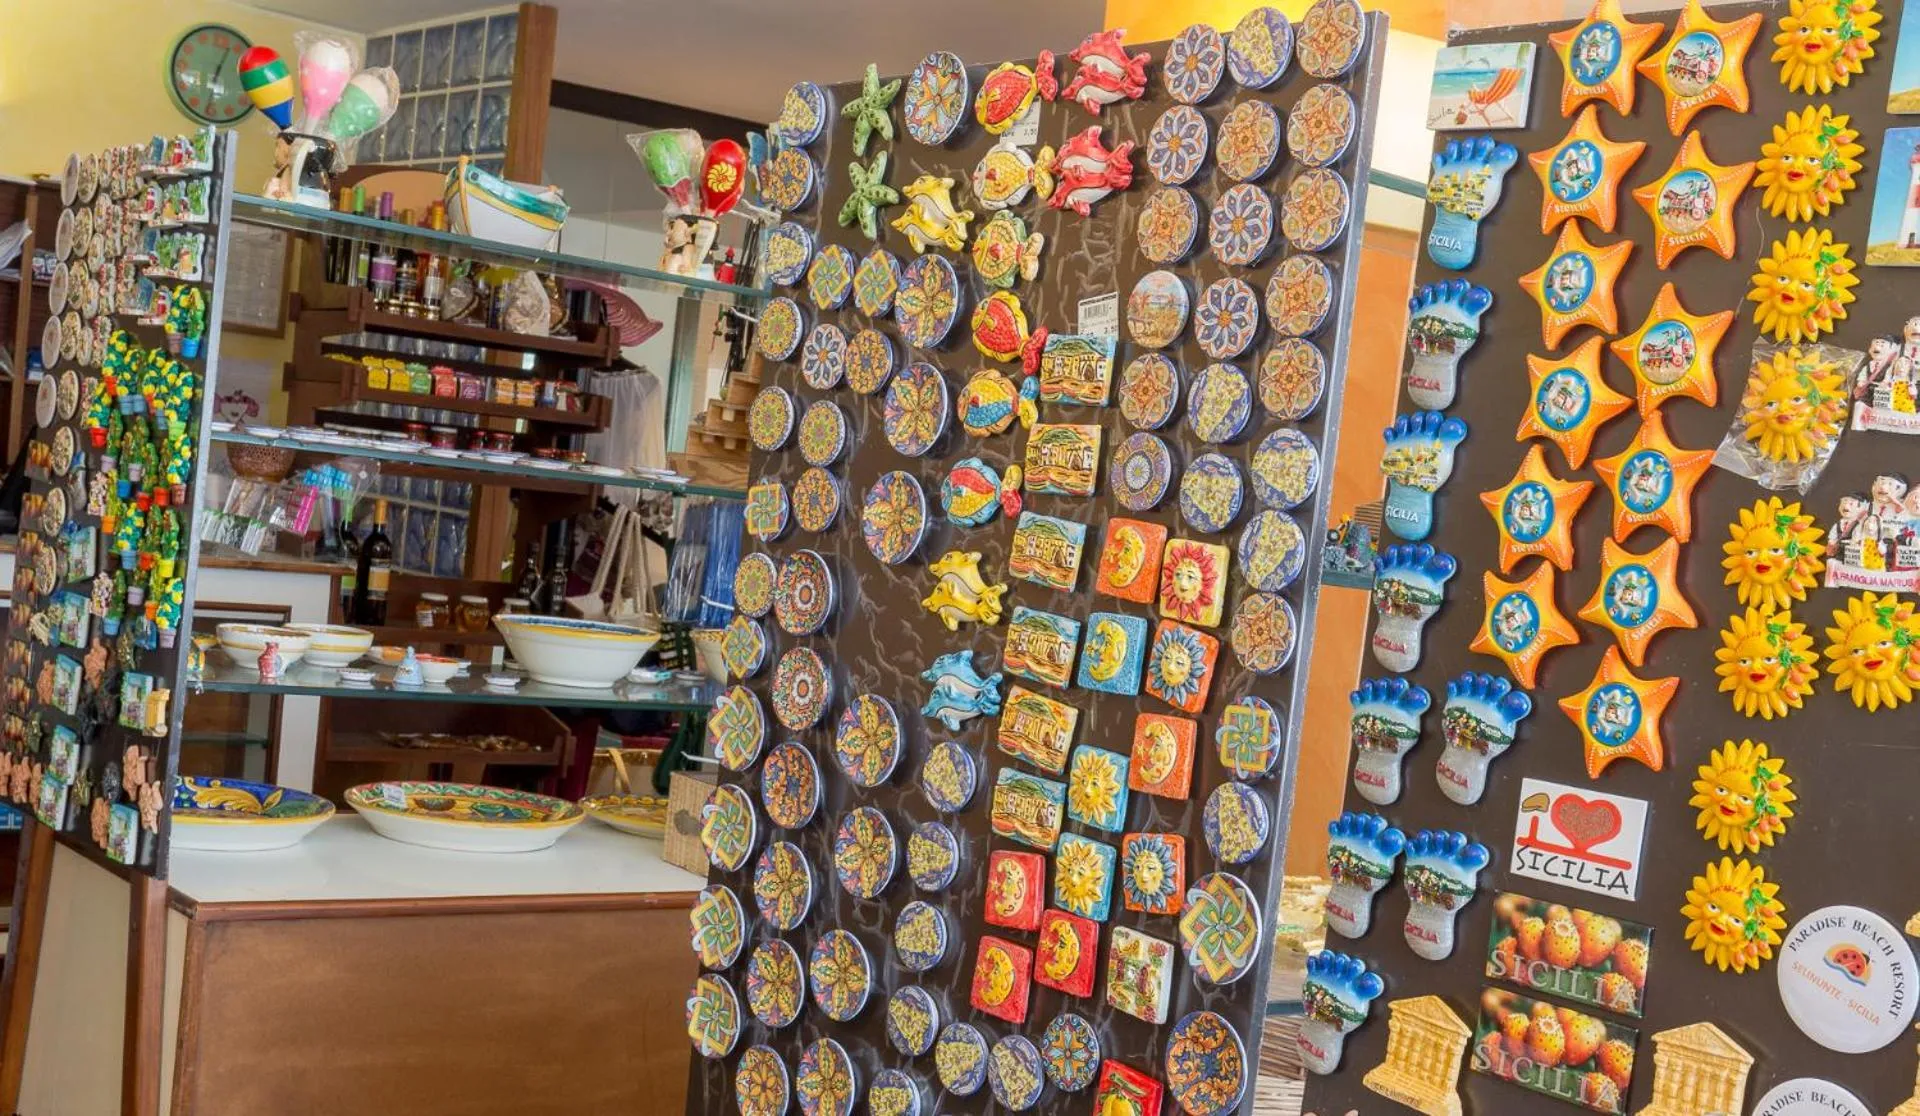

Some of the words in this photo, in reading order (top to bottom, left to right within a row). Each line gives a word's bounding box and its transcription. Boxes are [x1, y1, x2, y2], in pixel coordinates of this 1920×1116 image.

[1681, 87, 1720, 109] SICILIA
[1428, 233, 1462, 251] SICILIA
[1385, 504, 1420, 523] SICILIA
[1516, 845, 1630, 895] SICILIA
[1788, 916, 1847, 953] PARADISE
[1852, 919, 1895, 958] BEACH
[1888, 961, 1905, 1020] RESORT
[1490, 949, 1639, 1015] SICILIA
[1847, 998, 1881, 1025] SICILIA
[1475, 1044, 1624, 1114] SICILIA
[1762, 1090, 1804, 1116] RADISE
